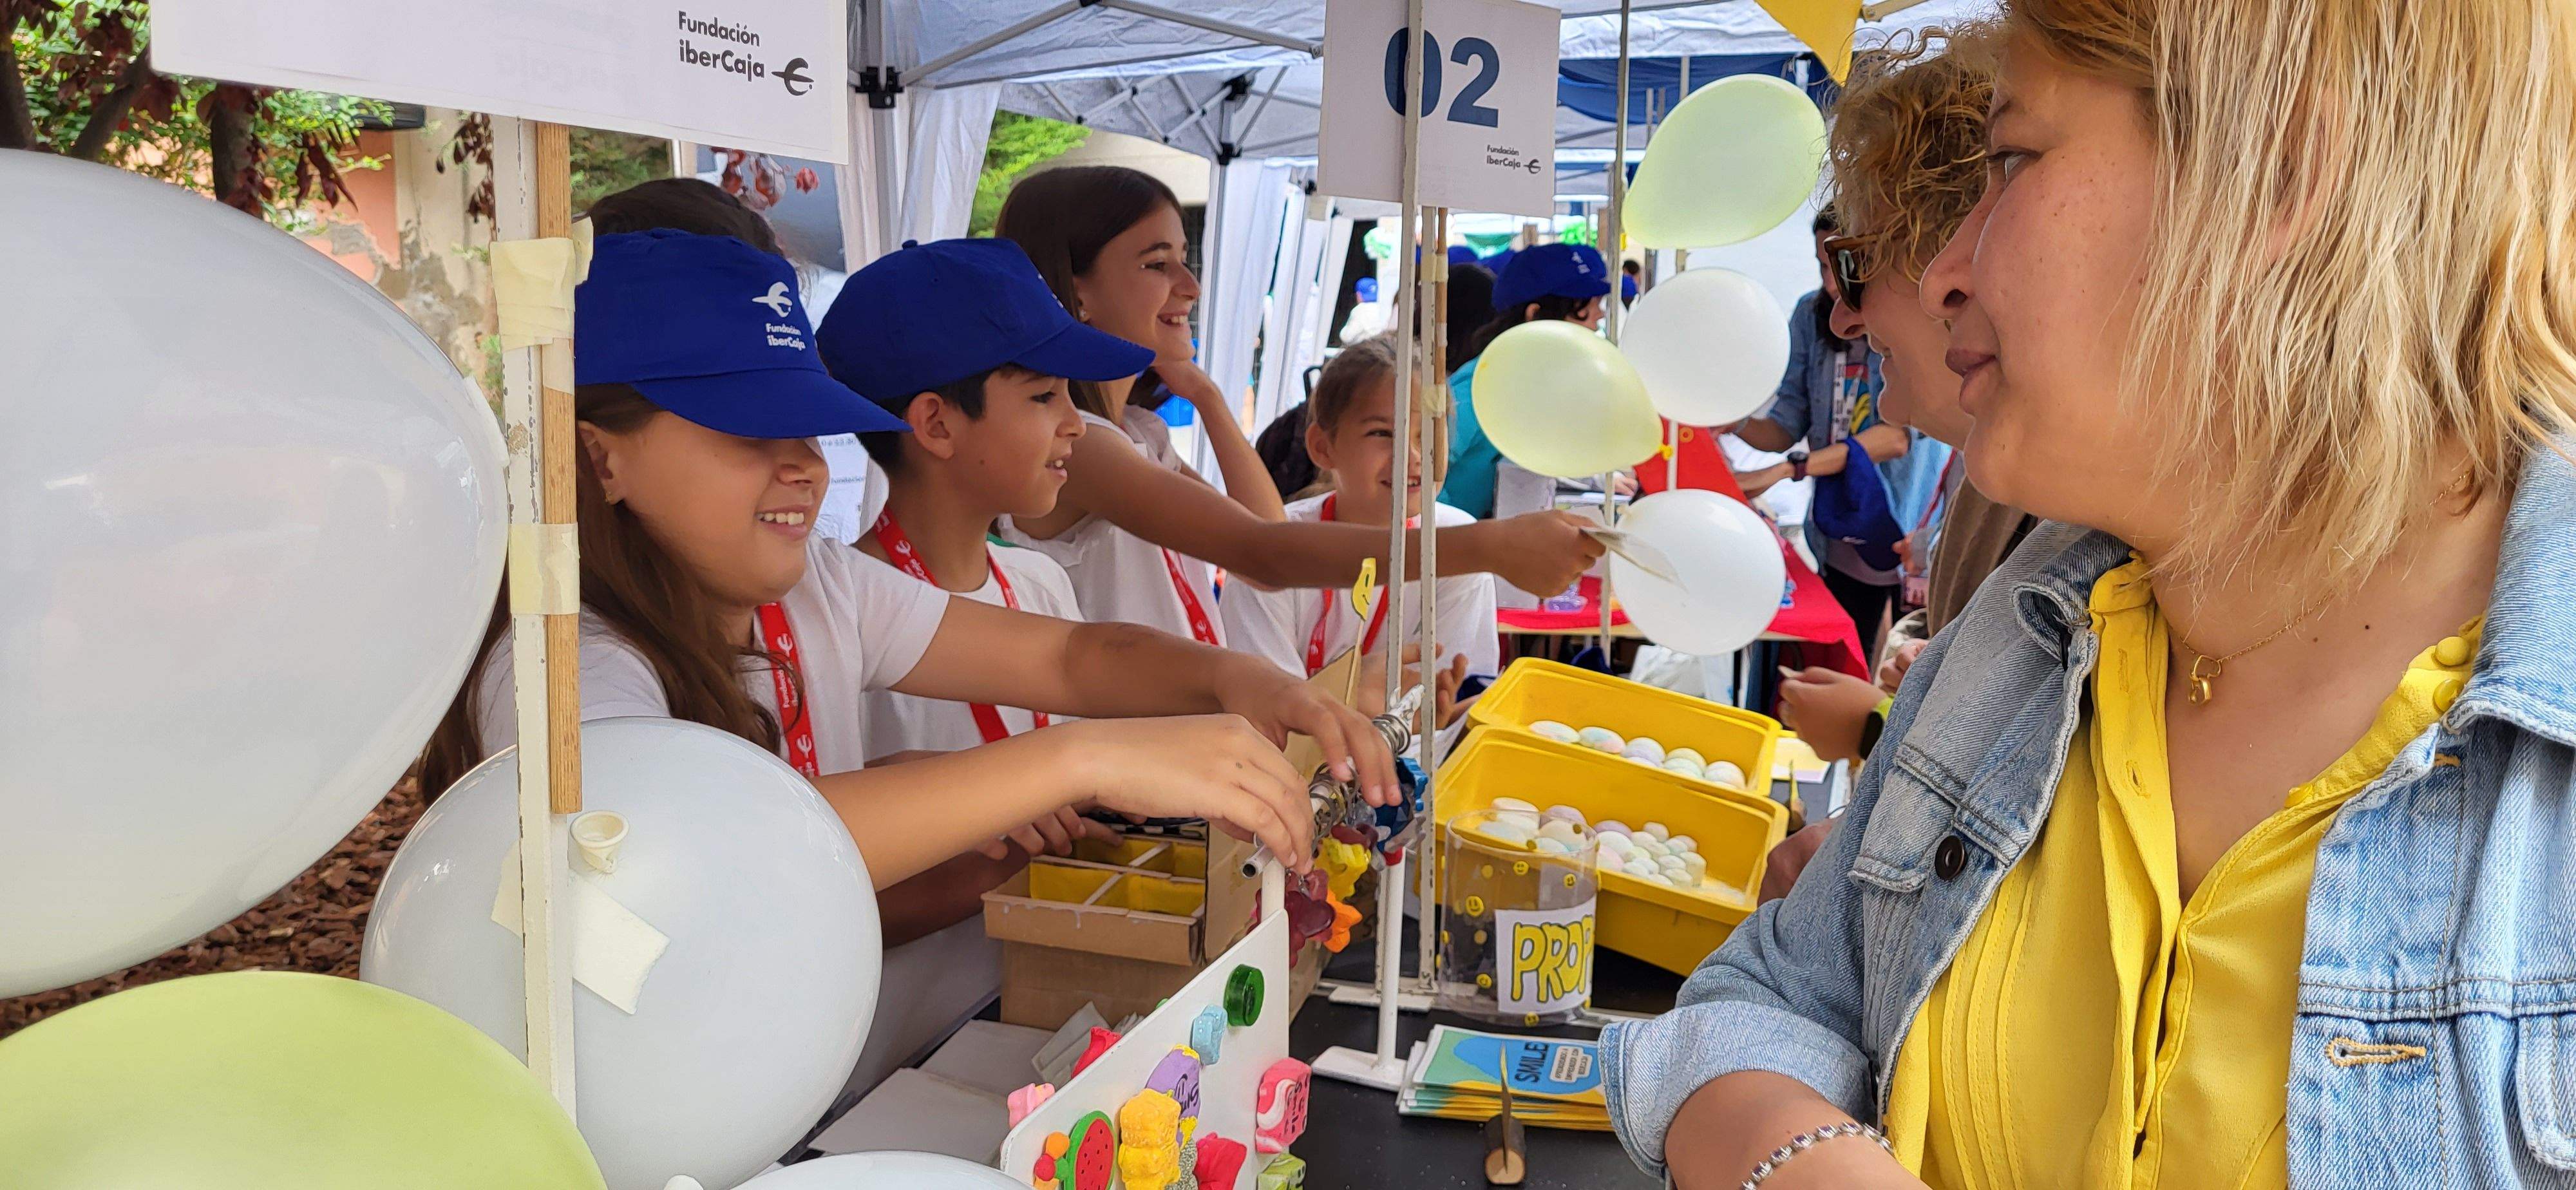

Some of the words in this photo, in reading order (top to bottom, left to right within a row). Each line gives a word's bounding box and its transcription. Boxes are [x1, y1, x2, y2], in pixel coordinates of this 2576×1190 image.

[678, 10, 761, 47] Fundación
[679, 39, 765, 82] iberCaja
[1384, 27, 1500, 128] 02
[1486, 144, 1520, 156] Fundación
[1514, 1041, 1549, 1083] SMILE
